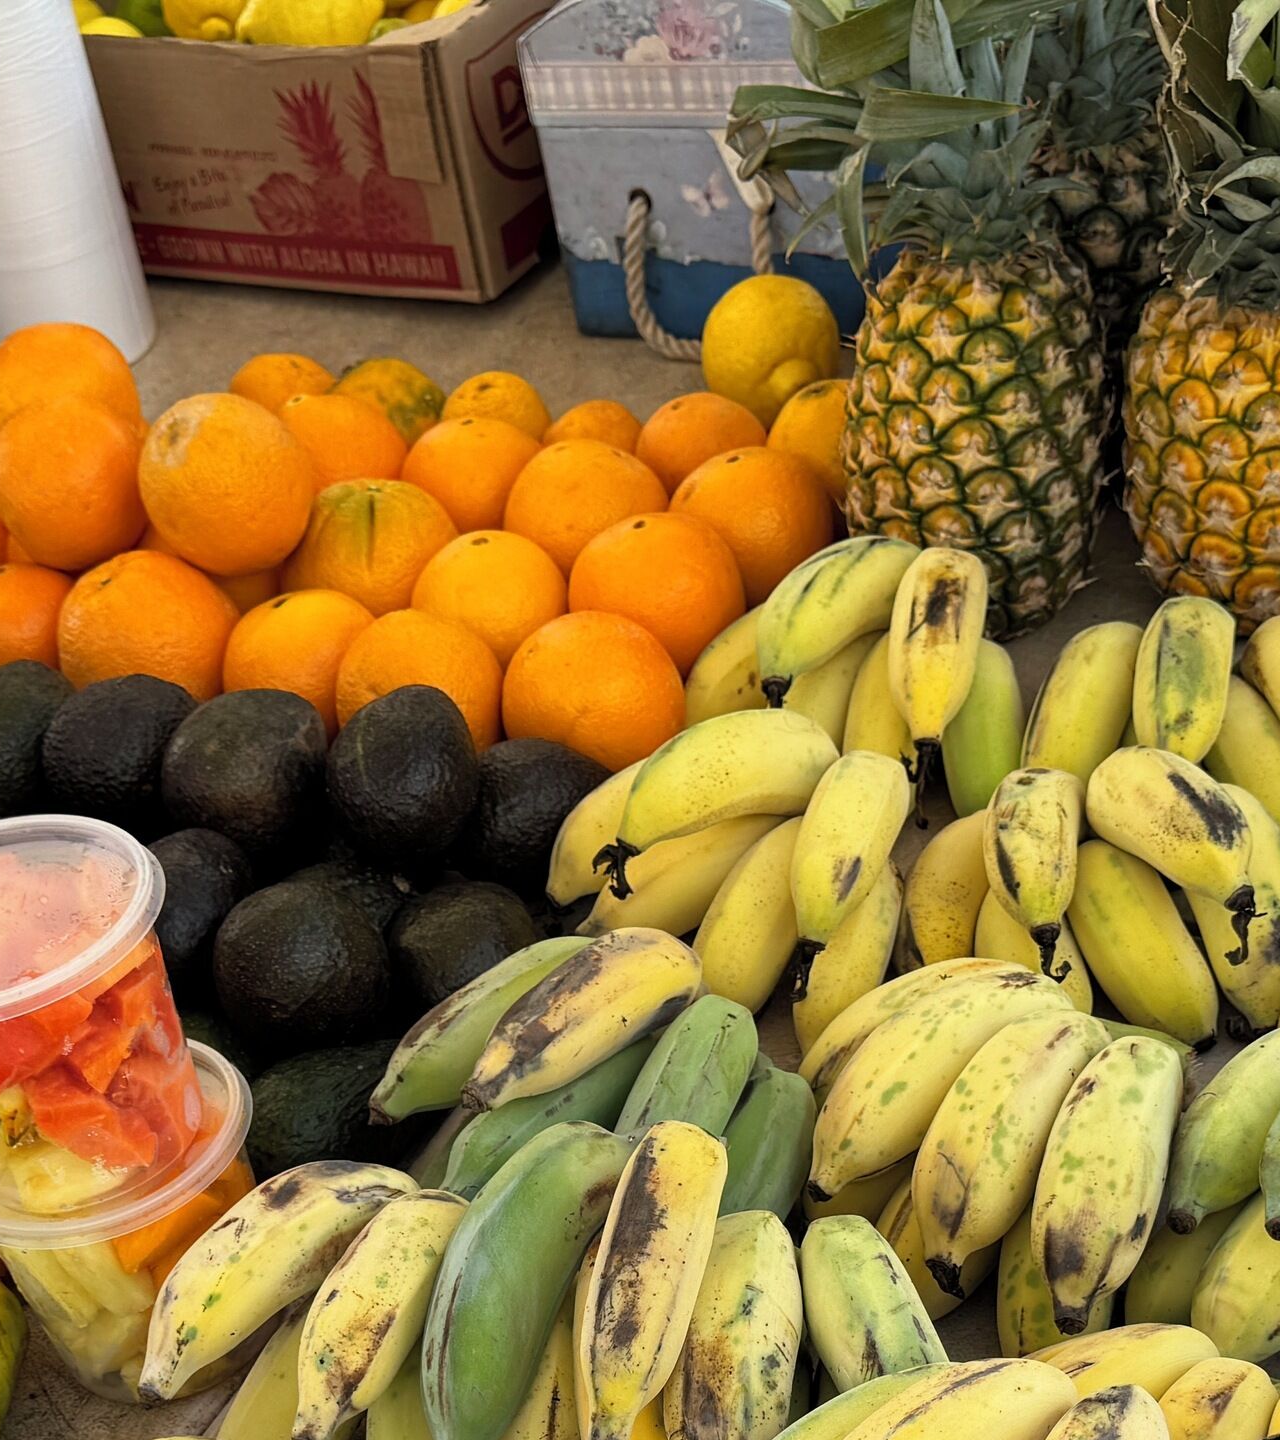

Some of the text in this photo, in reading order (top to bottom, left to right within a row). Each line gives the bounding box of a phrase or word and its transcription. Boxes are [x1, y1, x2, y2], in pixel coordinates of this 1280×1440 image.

[157, 234, 226, 263] GROWN
[223, 241, 278, 269] WITH
[278, 246, 346, 274] ALOHA
[344, 250, 371, 275] IN
[370, 252, 448, 282] HAWAII
